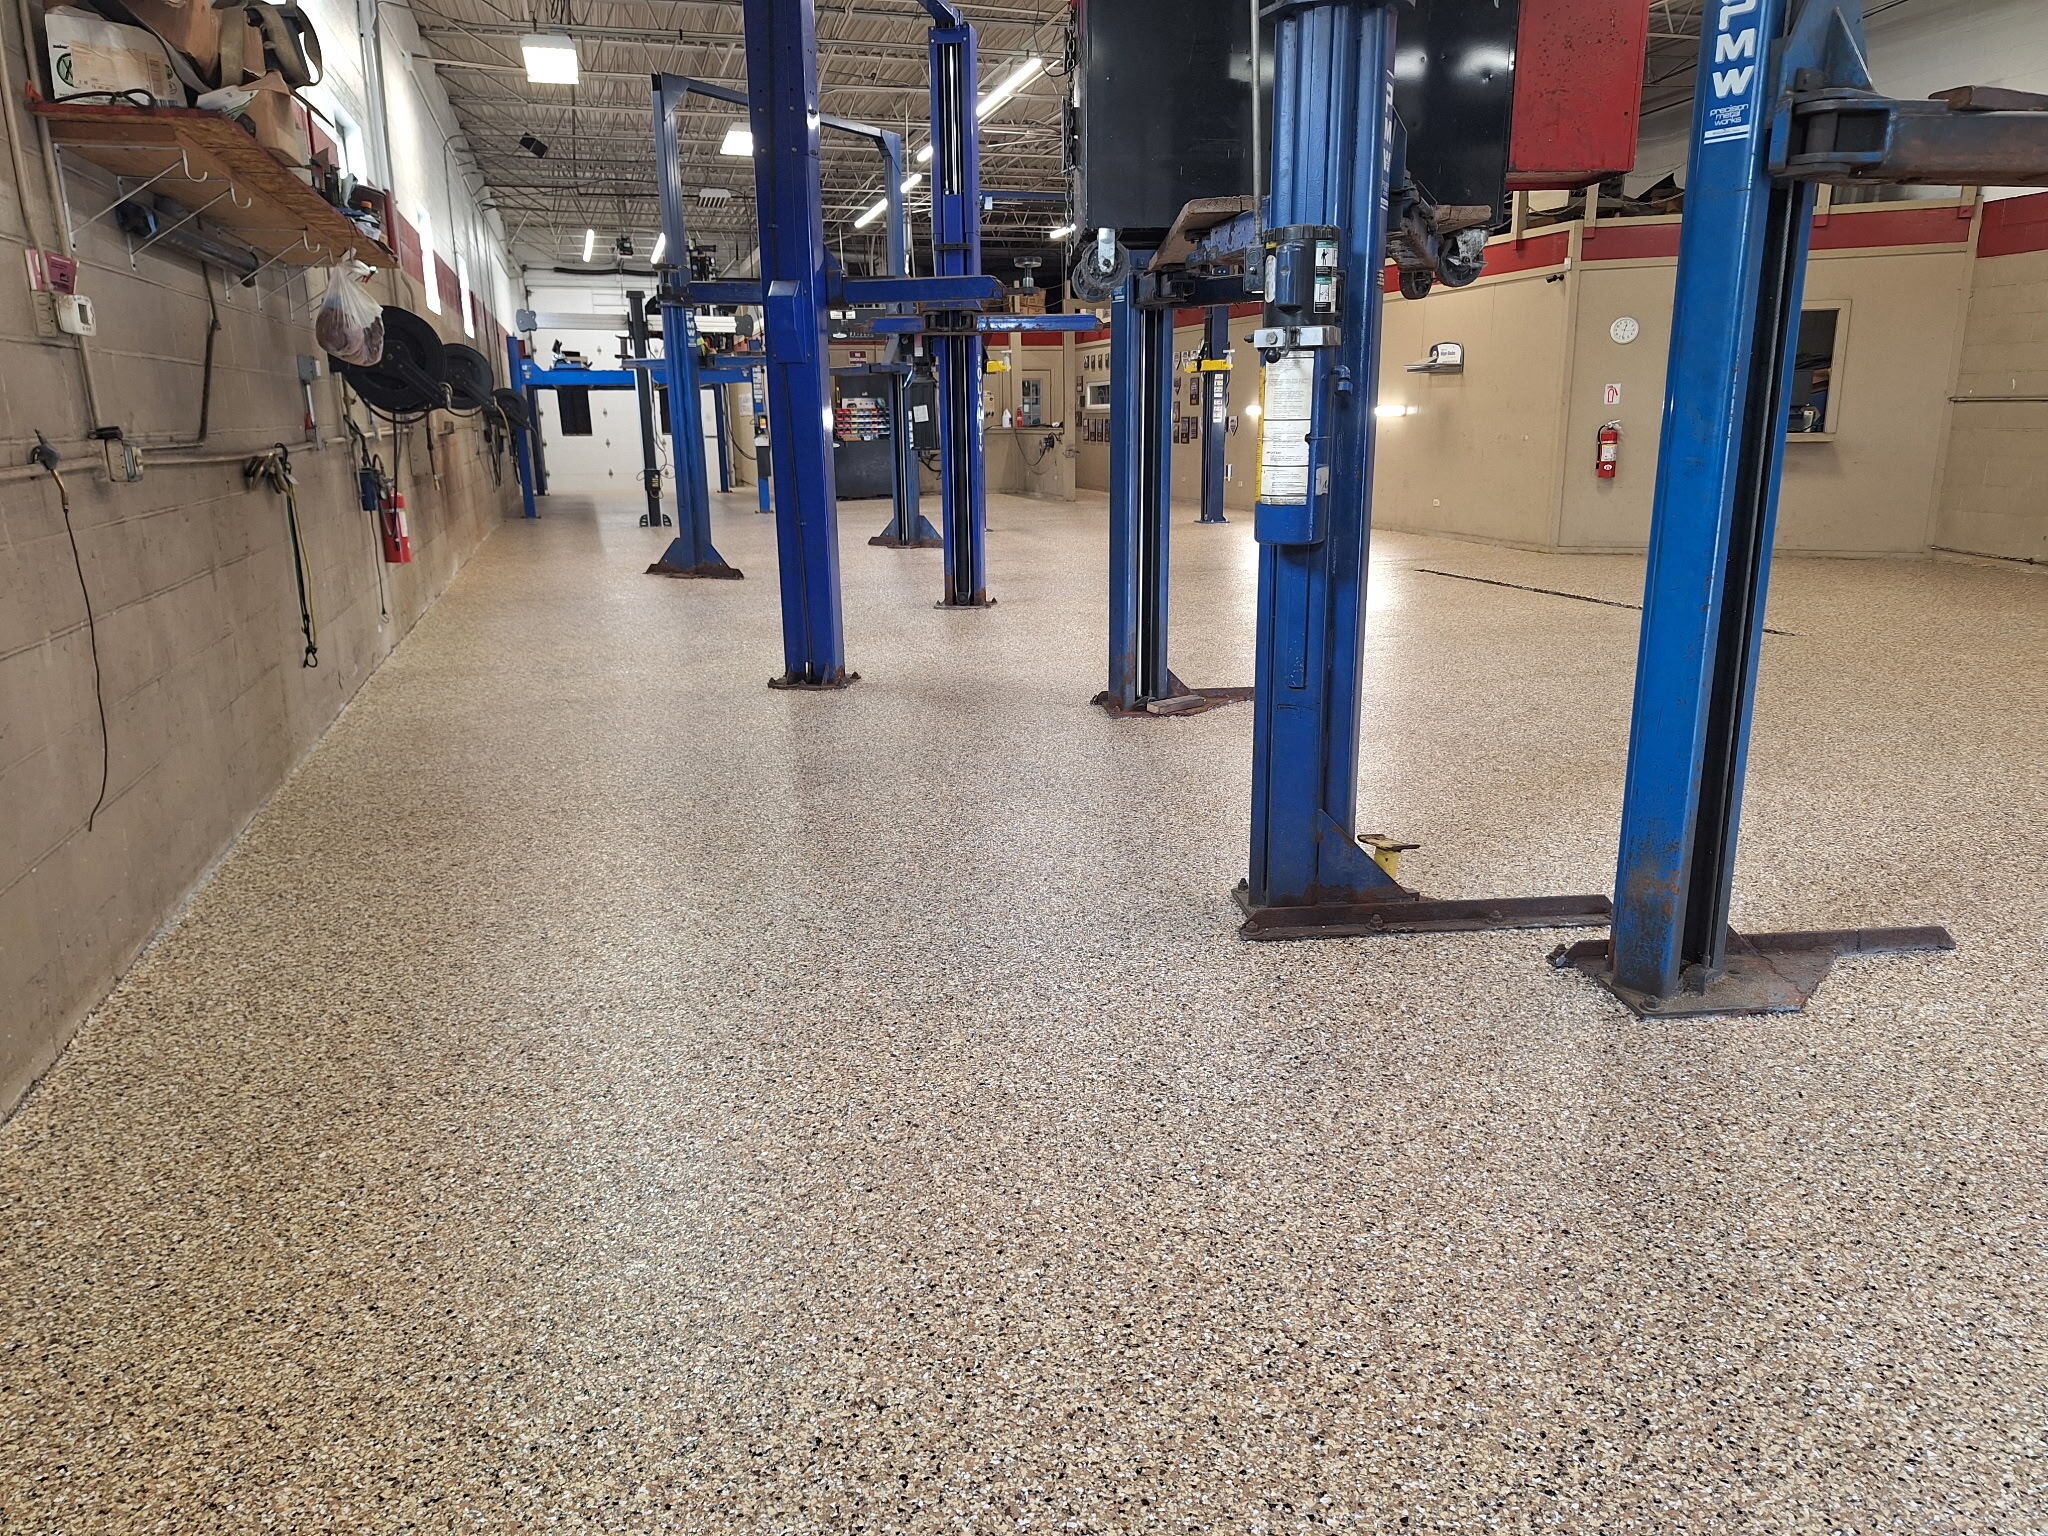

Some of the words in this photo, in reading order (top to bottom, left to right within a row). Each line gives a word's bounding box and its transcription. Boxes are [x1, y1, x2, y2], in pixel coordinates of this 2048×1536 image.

[1709, 103, 1749, 117] precision
[1715, 109, 1741, 121] metal
[1714, 116, 1742, 126] works
[685, 311, 696, 337] PMW
